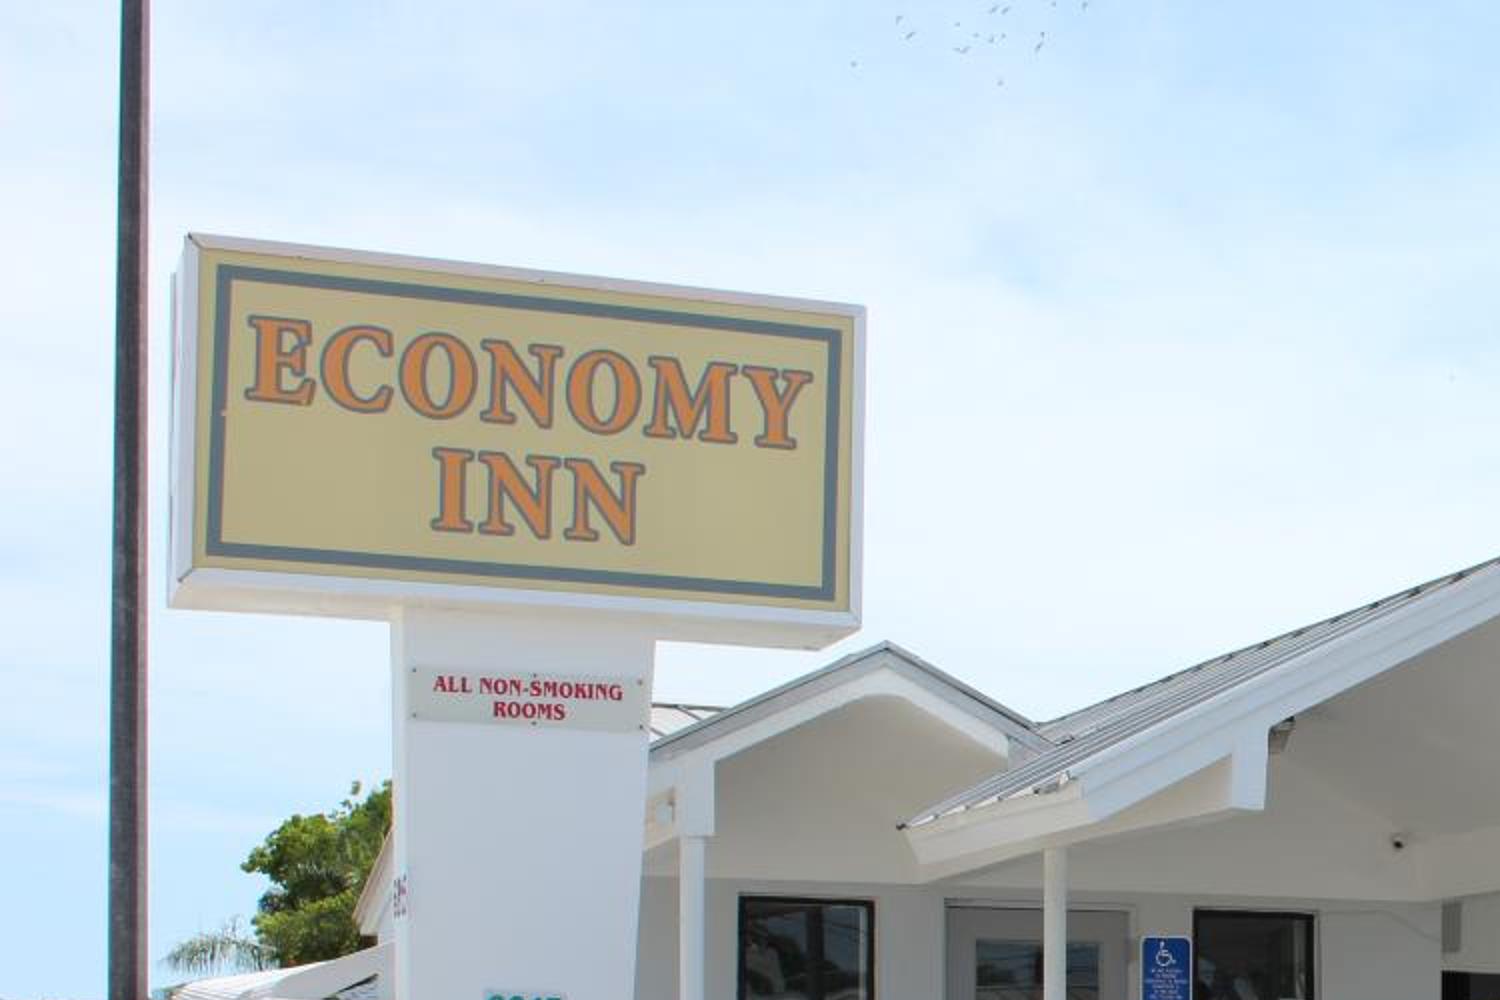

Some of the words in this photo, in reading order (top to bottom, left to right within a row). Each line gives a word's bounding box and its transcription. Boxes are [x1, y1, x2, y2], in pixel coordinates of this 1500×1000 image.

[244, 314, 814, 450] ECONOMY
[431, 446, 645, 546] INN
[432, 675, 473, 693] ALL
[479, 677, 624, 701] NON-SMOKING
[493, 701, 567, 721] ROOMS
